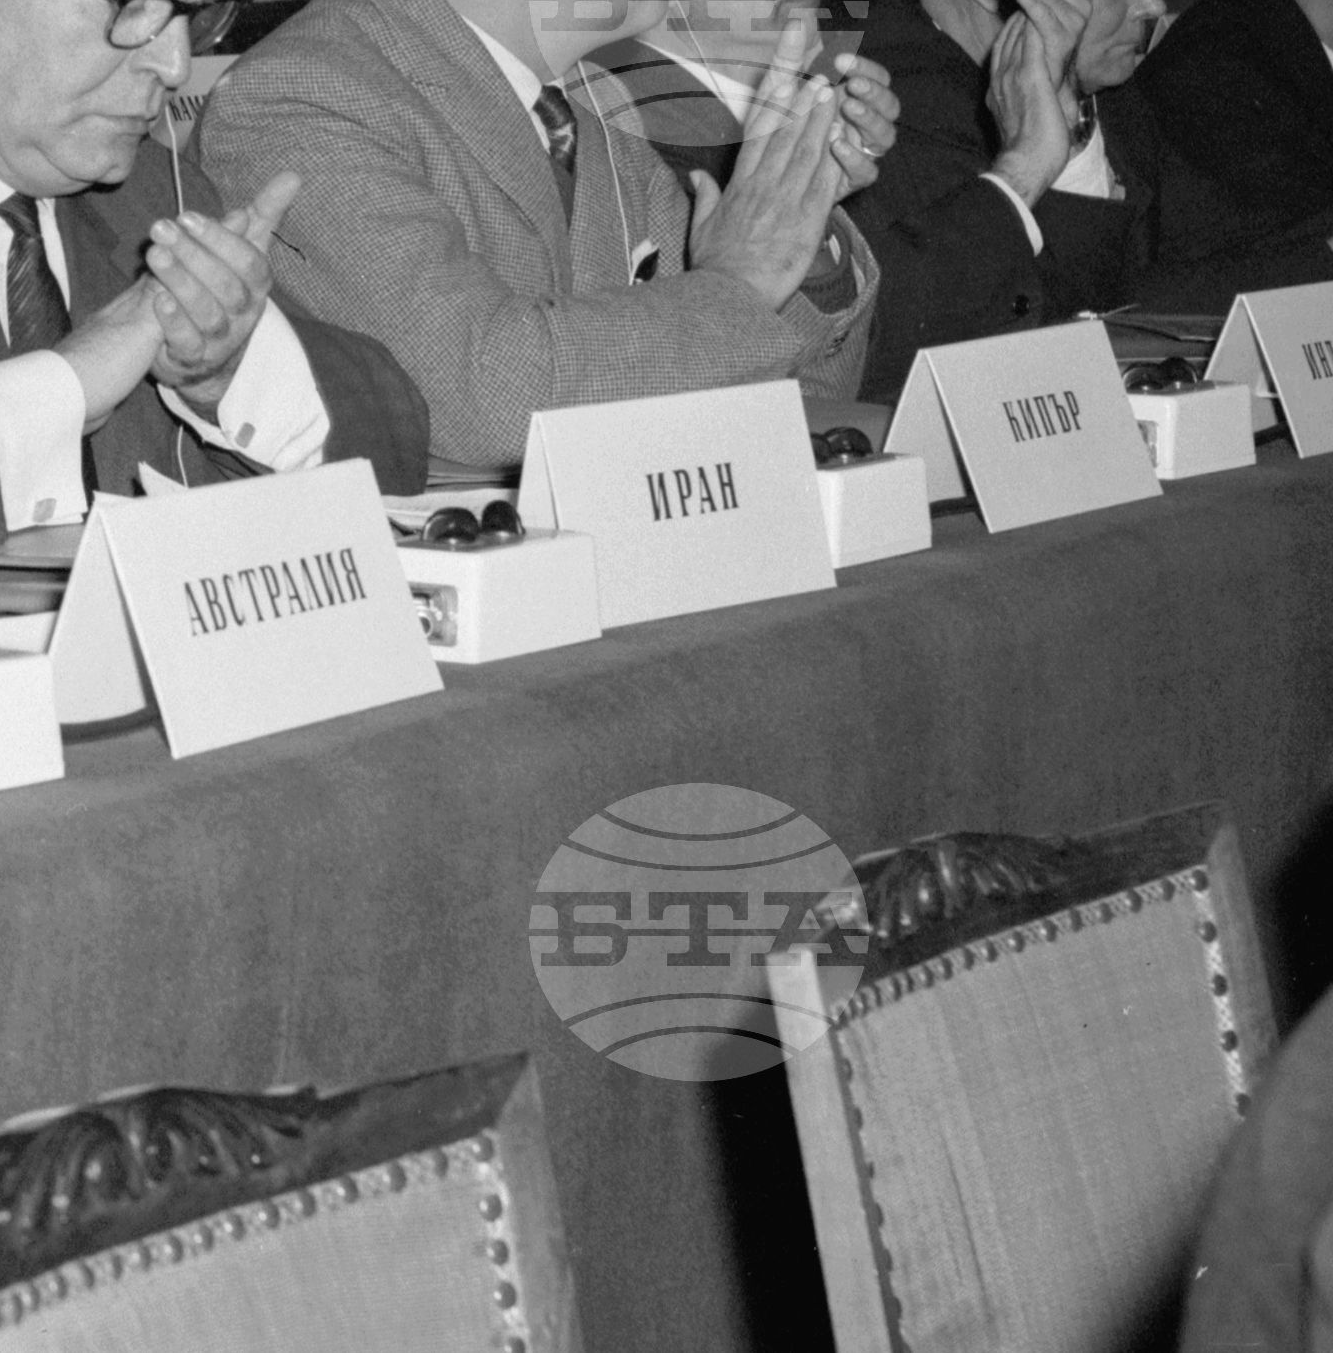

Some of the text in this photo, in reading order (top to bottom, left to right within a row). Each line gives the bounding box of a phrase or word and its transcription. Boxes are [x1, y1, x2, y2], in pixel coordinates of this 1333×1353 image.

[1002, 390, 1082, 443] КИПЪР
[646, 461, 739, 522] ИРАН
[183, 547, 368, 637] АВСТРАЛИЯ
